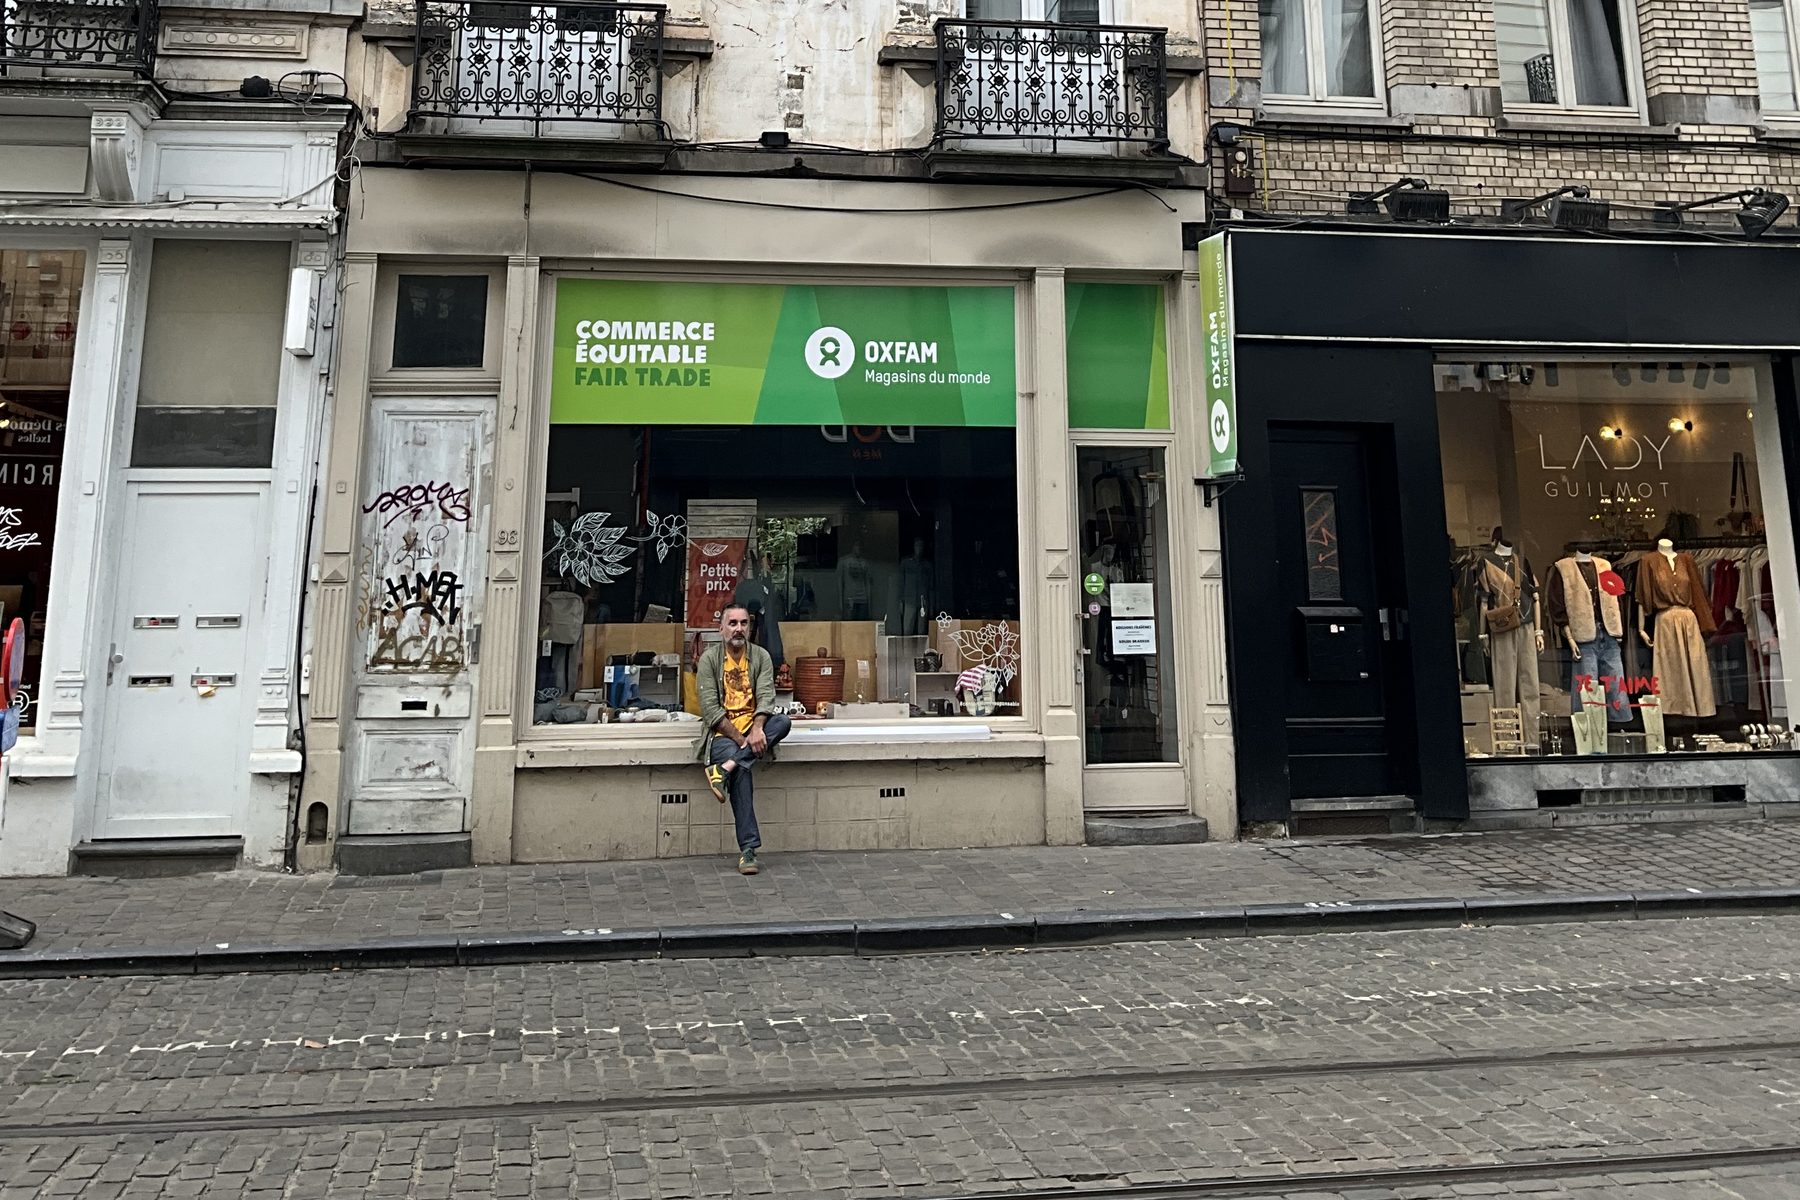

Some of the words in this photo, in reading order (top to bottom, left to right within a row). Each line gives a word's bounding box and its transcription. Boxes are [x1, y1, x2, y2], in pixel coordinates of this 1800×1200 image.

[1217, 253, 1225, 298] monde
[576, 320, 715, 341] COMMERCE
[575, 339, 707, 364] ÉQUITABLE
[864, 340, 938, 364] OXFAM
[1209, 311, 1221, 389] OXFAM
[1220, 321, 1229, 387] Magasins
[575, 367, 628, 386] FAIR
[635, 368, 711, 387] TRADE
[865, 369, 926, 386] Magasins
[929, 370, 945, 383] du
[949, 371, 991, 384] monde
[1539, 434, 1671, 470] LADY
[1544, 482, 1669, 498] GUILMOT
[498, 529, 518, 546] 96
[700, 563, 738, 577] Petits
[706, 578, 731, 594] prix
[371, 627, 464, 669] ACAB
[1575, 674, 1594, 693] JE
[1600, 675, 1661, 695] T'AIME
